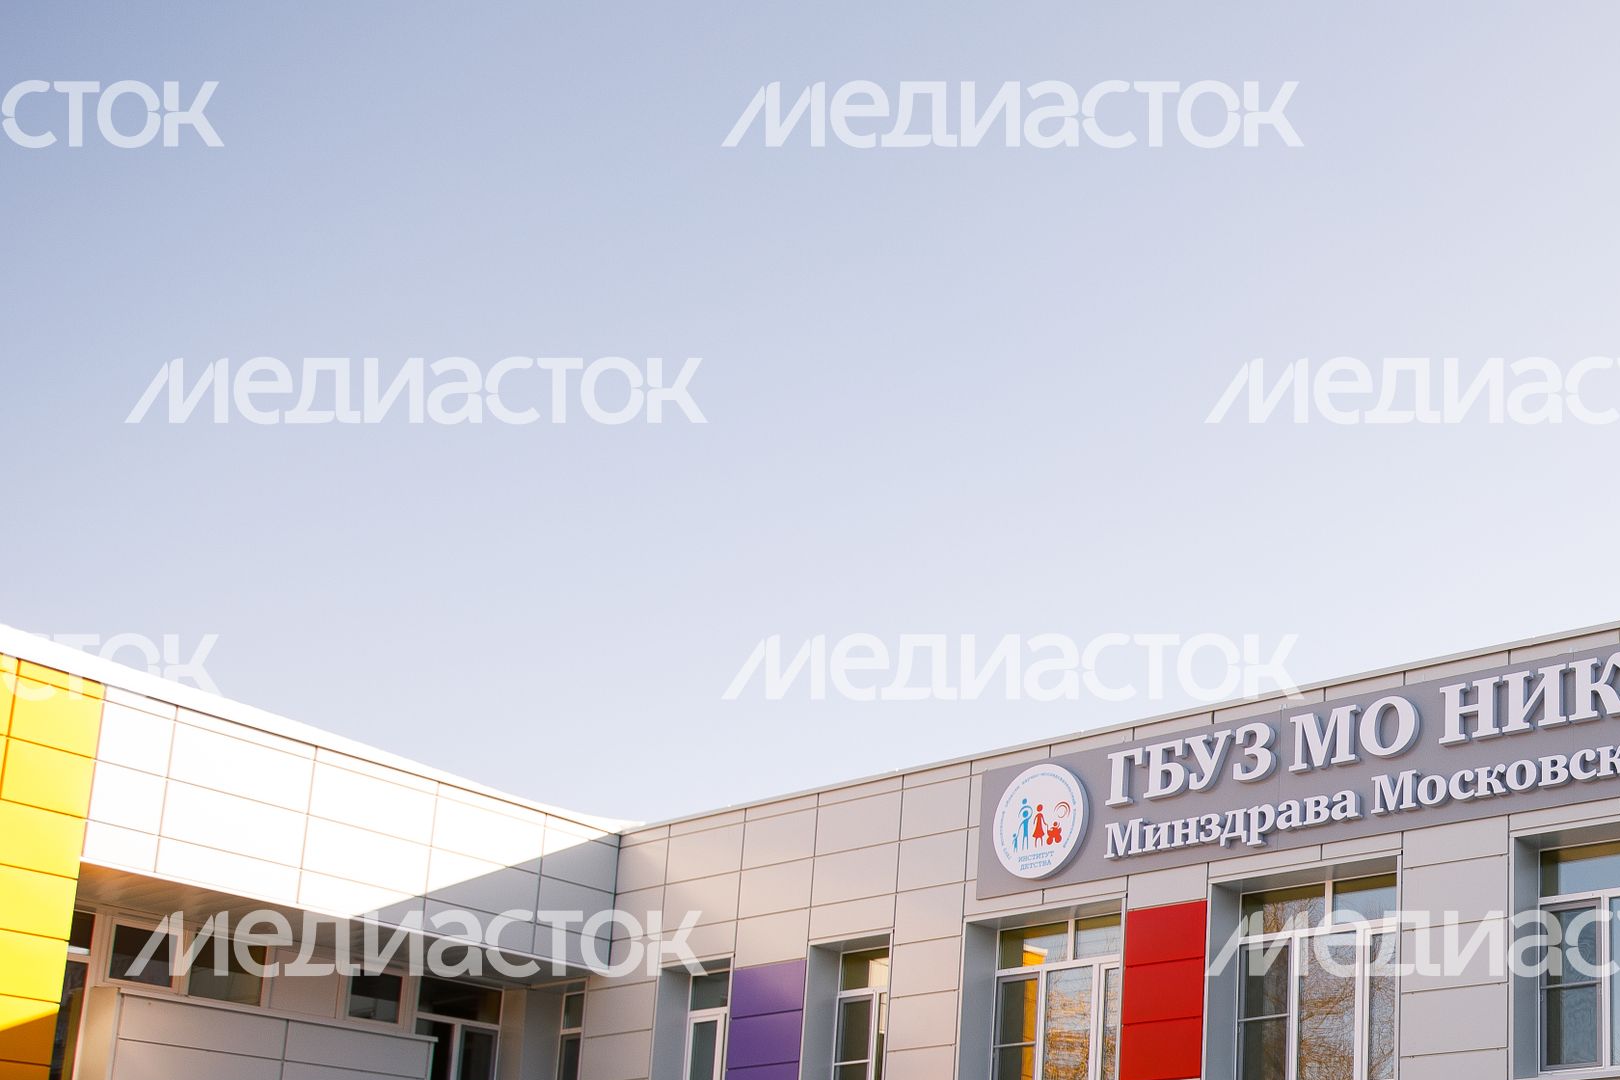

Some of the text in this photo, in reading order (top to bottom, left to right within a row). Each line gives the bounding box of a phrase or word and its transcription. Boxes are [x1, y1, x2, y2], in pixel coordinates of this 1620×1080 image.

[1105, 722, 1277, 806] ГБУЗ
[1288, 696, 1422, 772] МО
[1103, 789, 1362, 859] Минздрава
